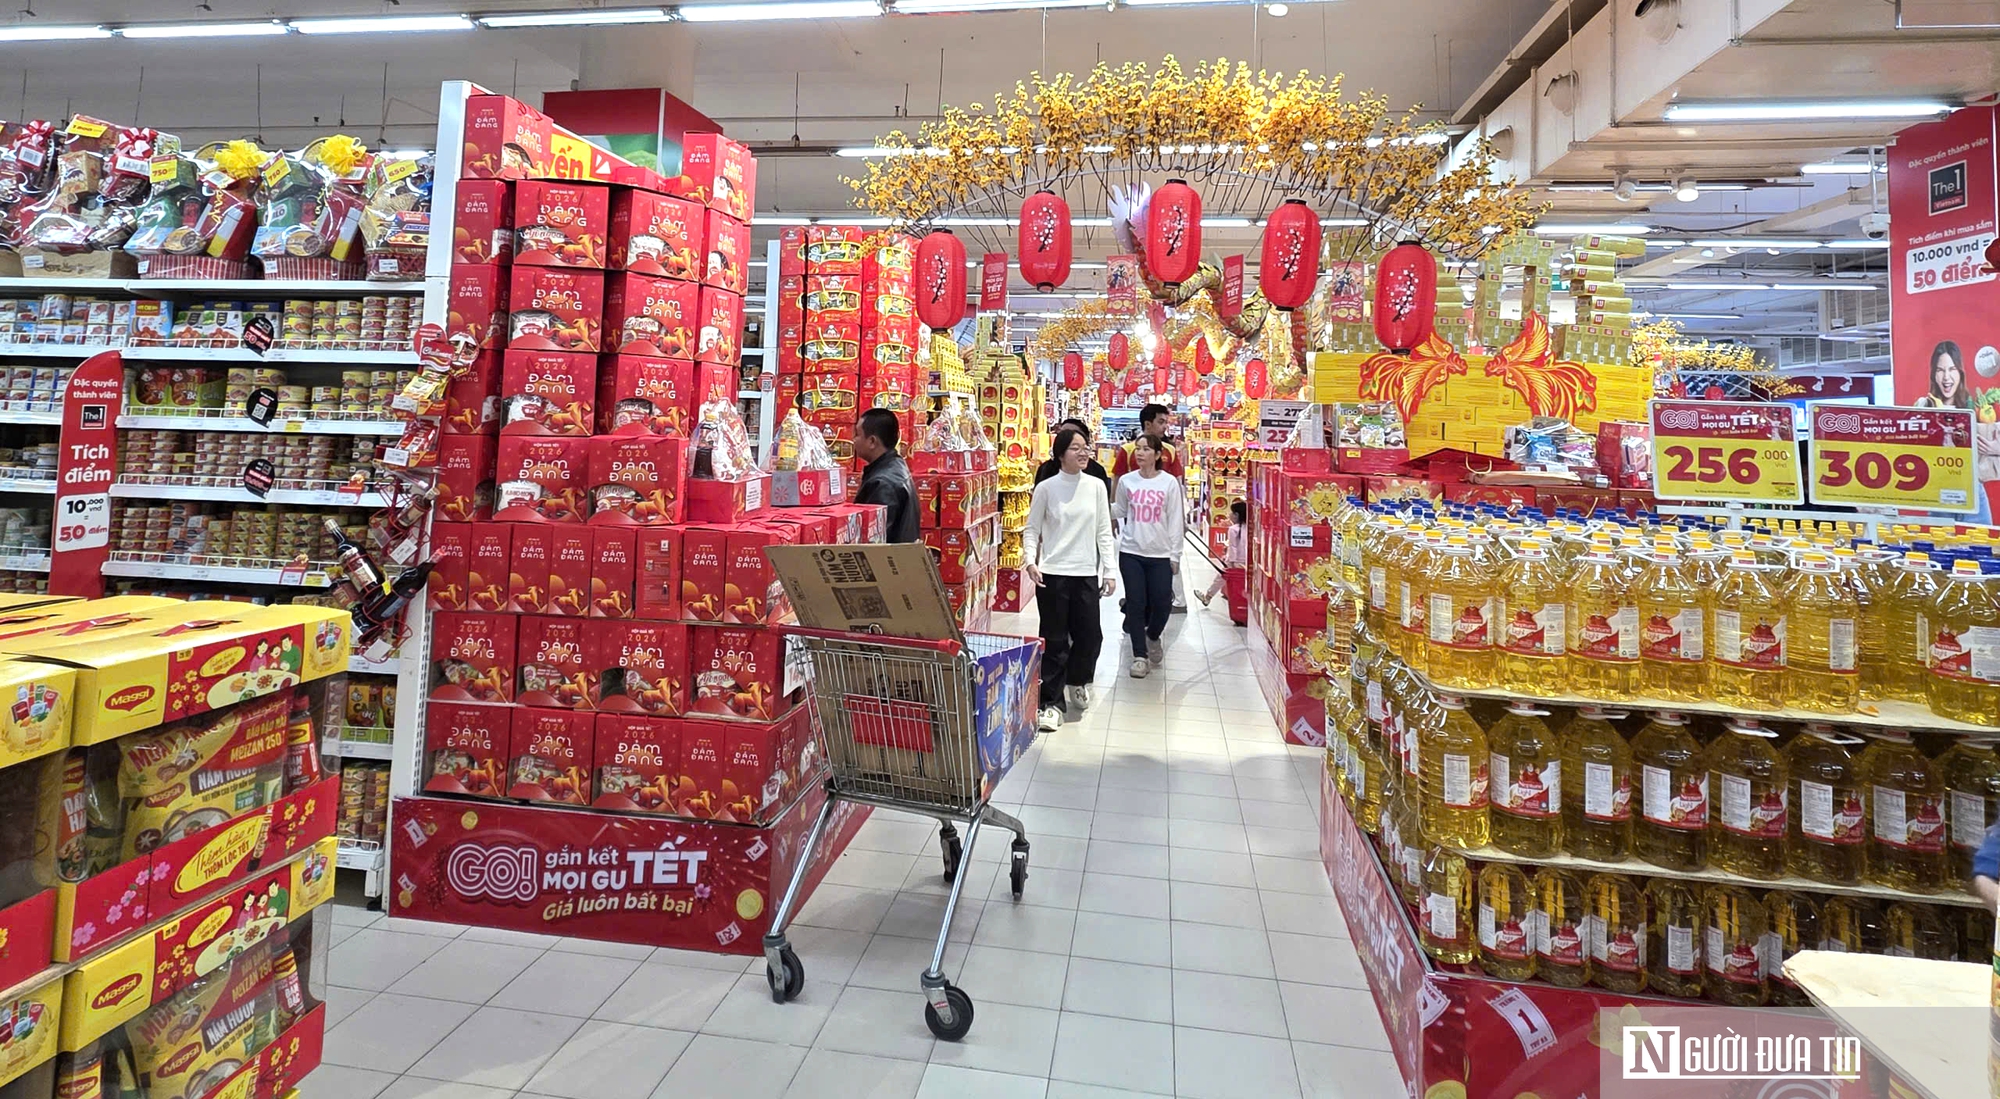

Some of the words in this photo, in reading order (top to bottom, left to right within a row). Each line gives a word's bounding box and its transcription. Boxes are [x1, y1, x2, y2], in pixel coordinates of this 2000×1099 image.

[1944, 228, 1956, 238] khi
[1912, 246, 1952, 263] 10.000
[1956, 239, 1979, 254] vnd
[1913, 269, 1936, 289] 50
[74, 379, 90, 388] Đặc
[1660, 409, 1699, 429] GO!
[1730, 410, 1759, 426] TẾT
[1819, 413, 1860, 434] GO!
[1897, 415, 1930, 431] TẾT
[1217, 431, 1232, 439] 68
[1864, 427, 1881, 435] MỌI
[71, 444, 109, 460] Tích
[65, 462, 111, 483] điểm
[1664, 445, 1761, 485] 256
[1819, 450, 1930, 491] 309
[609, 472, 658, 481] ĐANG
[1126, 488, 1165, 506] MISS
[59, 525, 85, 542] 50
[111, 688, 150, 707] Maggi
[624, 731, 654, 739] 2026
[615, 754, 663, 765] ĐANG
[150, 785, 180, 804] Maggi
[204, 860, 223, 879] THÊM
[447, 843, 538, 901] GO!
[545, 848, 581, 869] gắn
[587, 846, 618, 865] kết
[626, 836, 707, 885] TẾT
[543, 870, 586, 895] MỌI
[591, 869, 626, 891] GU
[543, 900, 572, 921] Giá
[578, 894, 616, 913] luôn
[624, 892, 657, 910] bất
[662, 896, 692, 916] bại
[98, 976, 137, 1005] Maggi
[1518, 1009, 1538, 1034] 1
[163, 1045, 199, 1074] Maggi
[61, 1079, 95, 1093] Maggi
